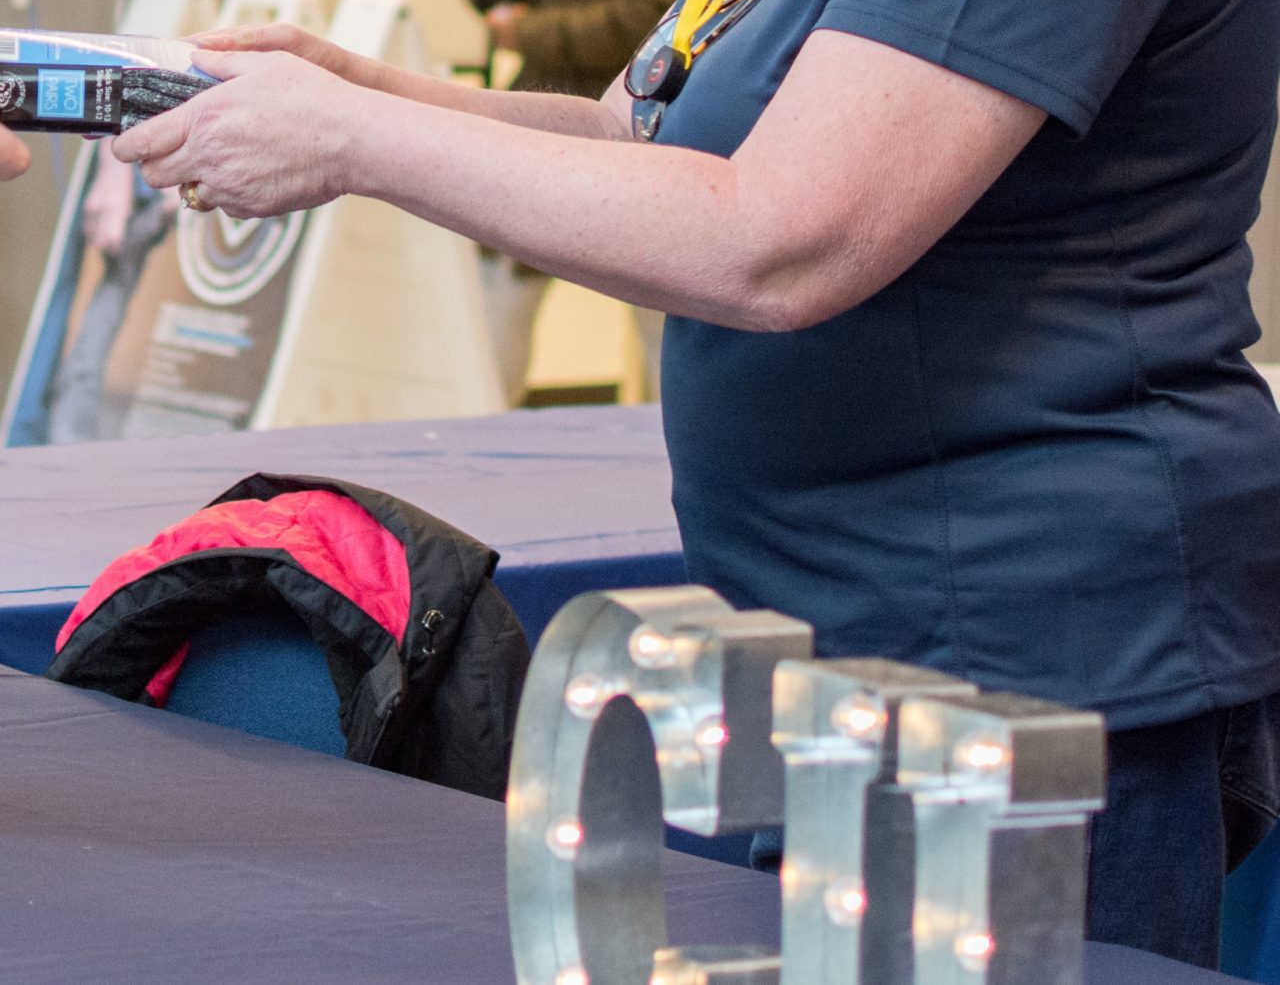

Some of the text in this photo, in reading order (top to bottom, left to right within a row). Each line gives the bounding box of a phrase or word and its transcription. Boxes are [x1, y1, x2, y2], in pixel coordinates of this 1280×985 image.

[45, 77, 59, 110] PAIRS
[63, 77, 79, 111] TWO
[104, 68, 113, 121] Sock Size: 10-13
